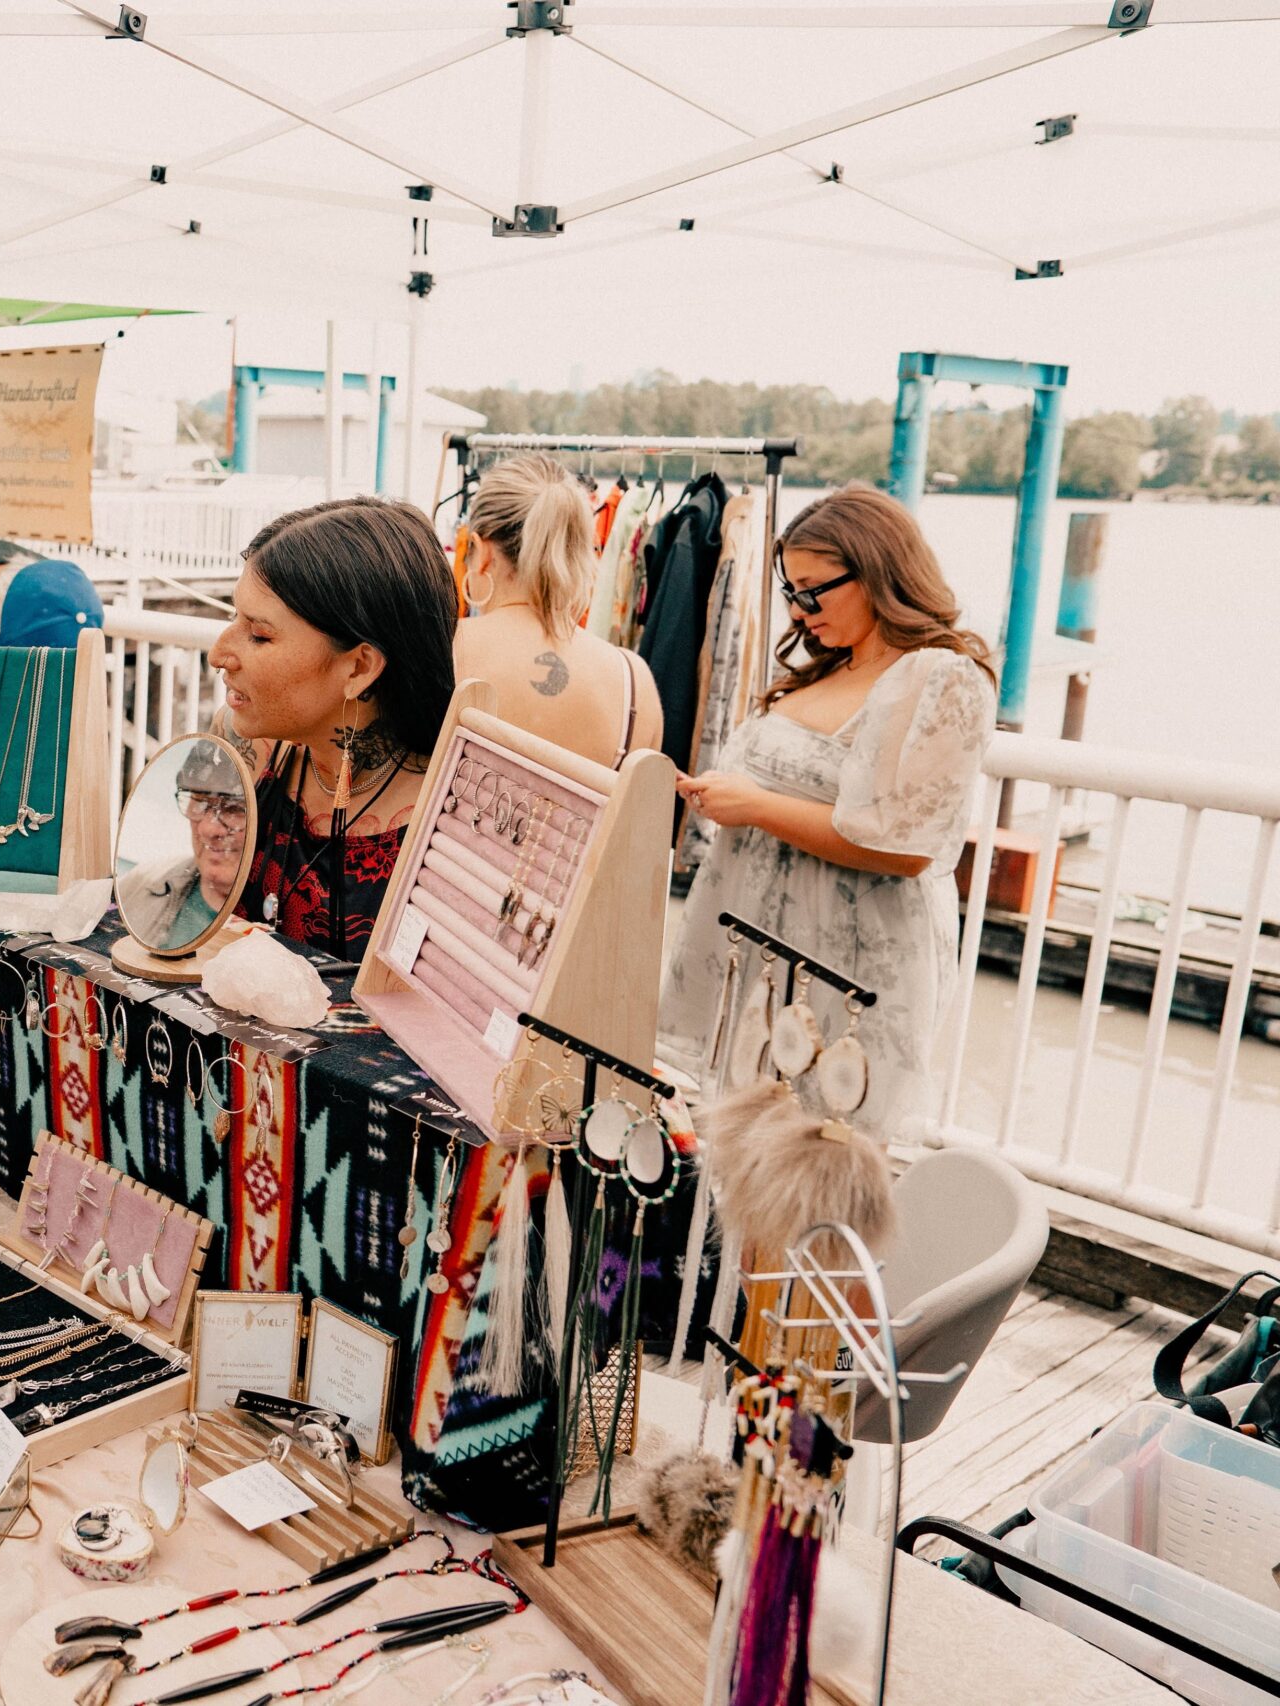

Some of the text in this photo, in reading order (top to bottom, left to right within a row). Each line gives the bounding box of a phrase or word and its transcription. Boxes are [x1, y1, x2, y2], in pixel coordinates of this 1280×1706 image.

[426, 1098, 458, 1113] INNER
[204, 1315, 240, 1327] INNER
[253, 1400, 286, 1412] INNER
